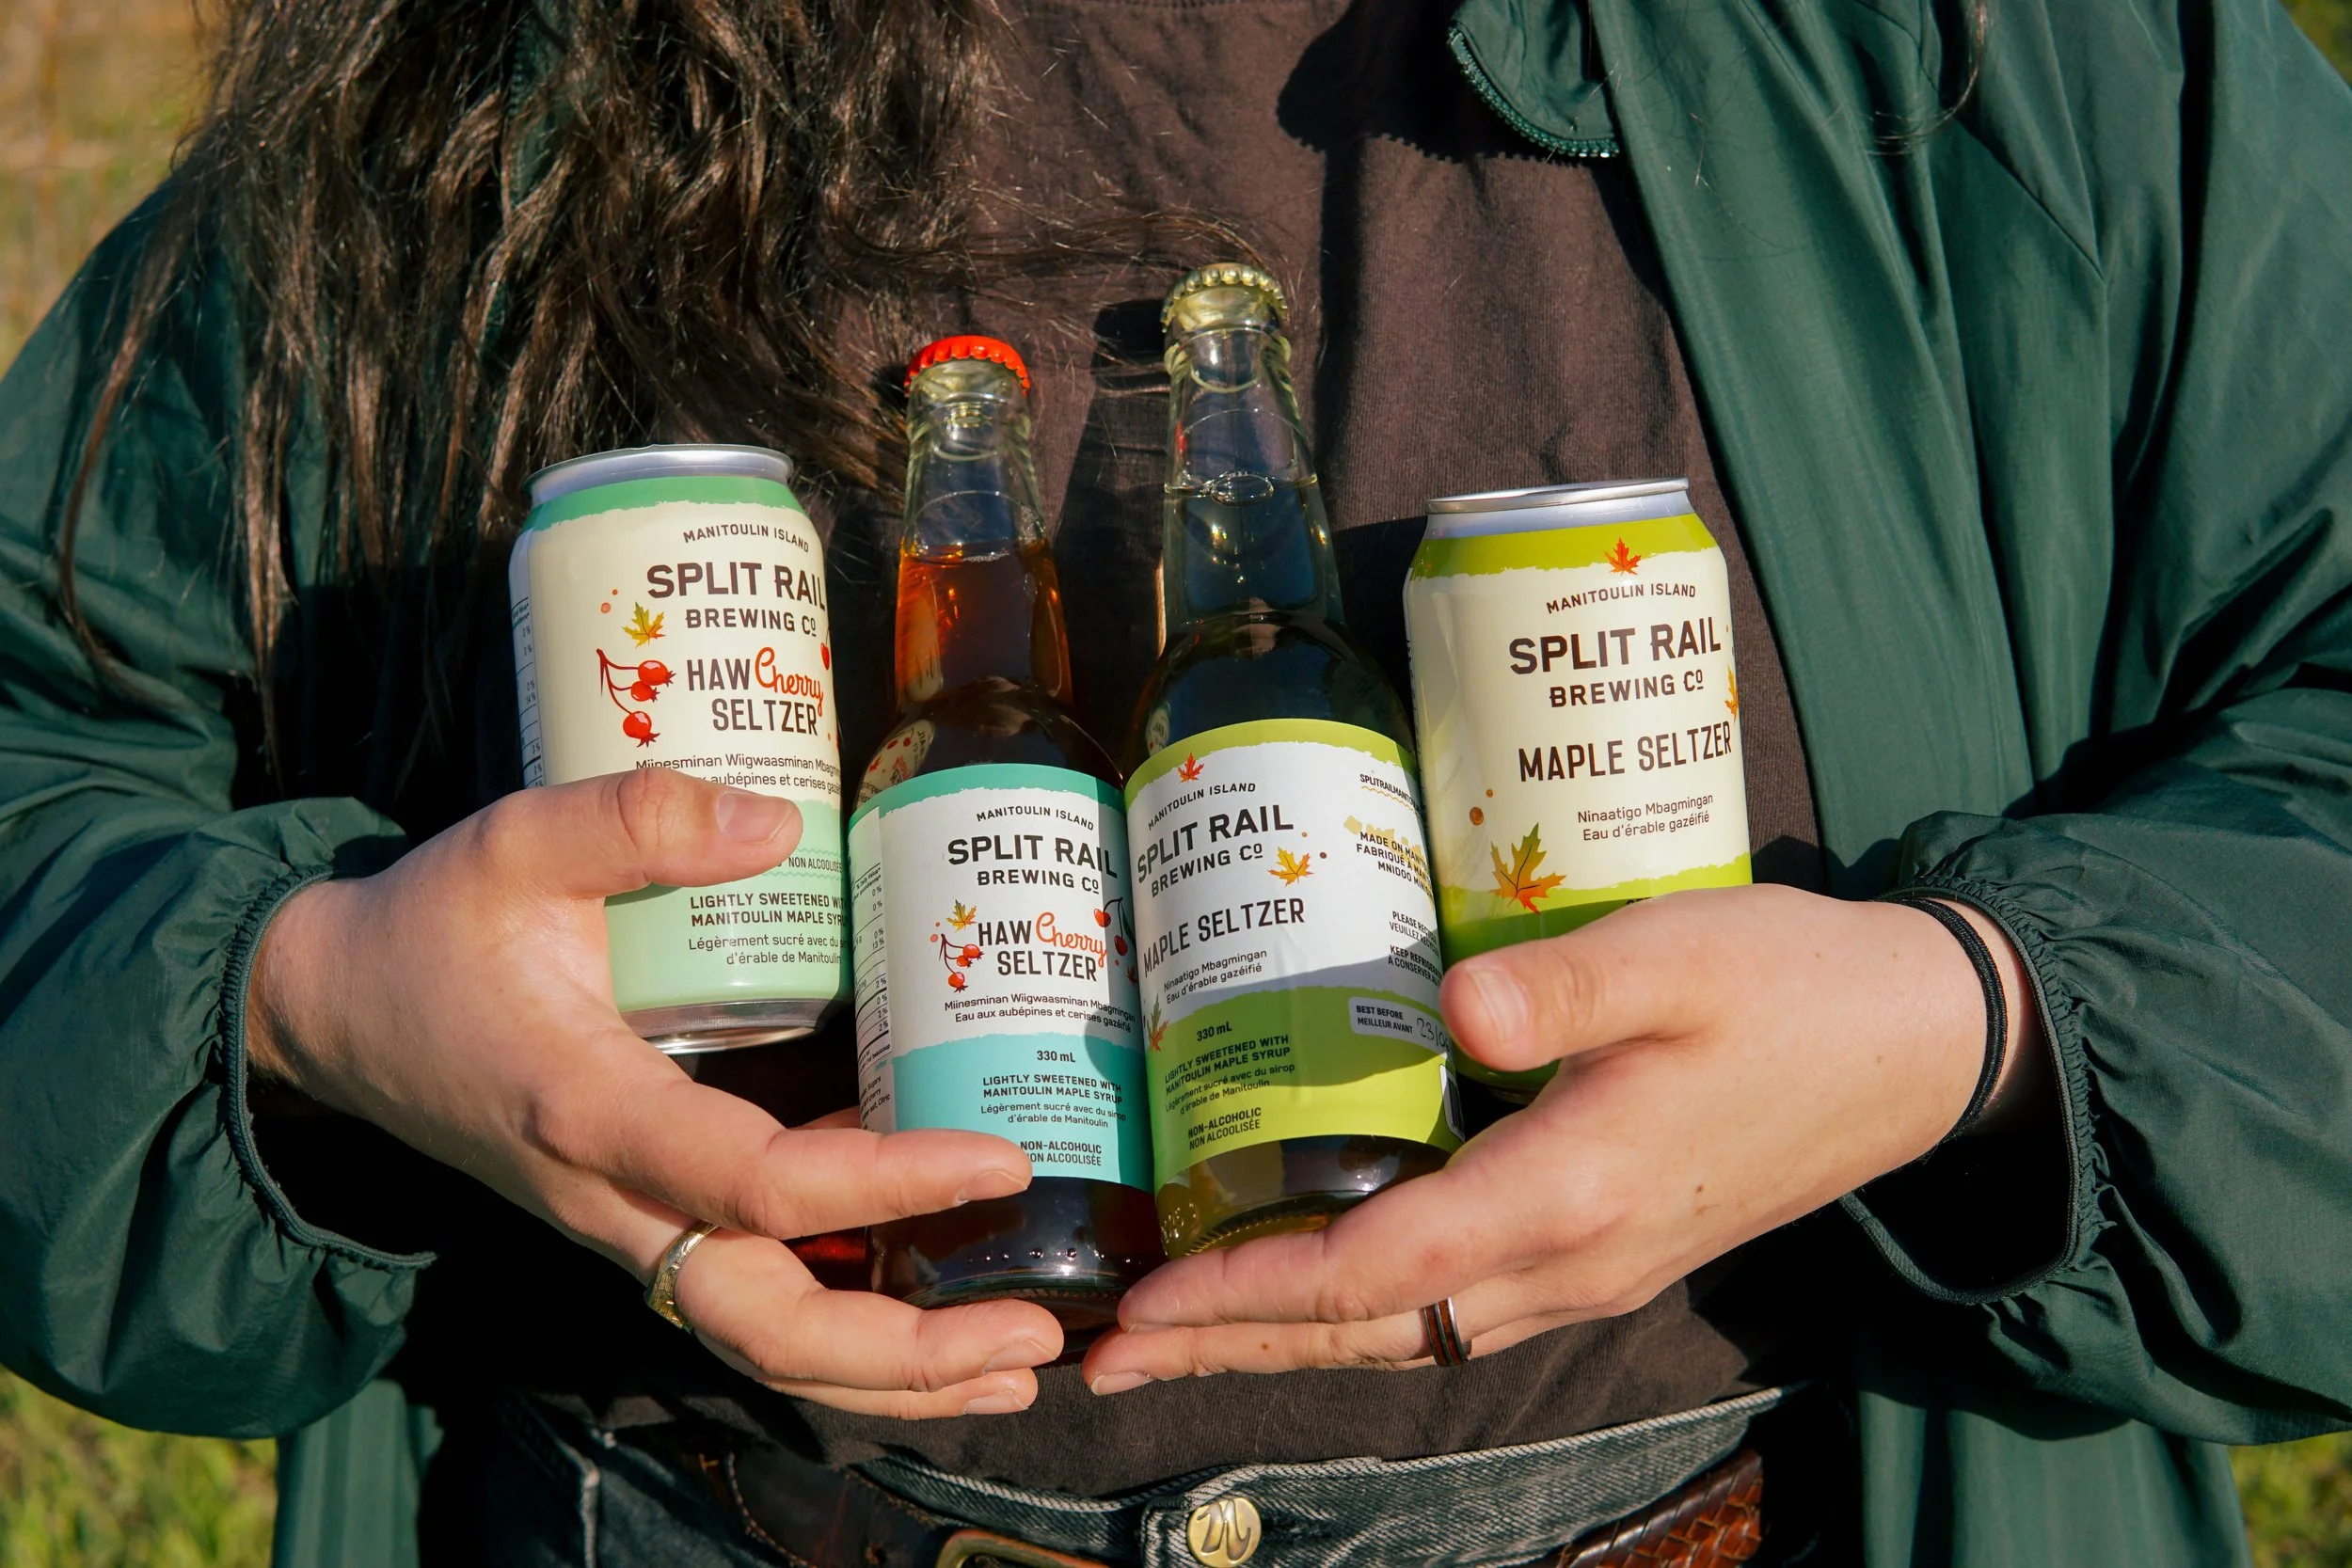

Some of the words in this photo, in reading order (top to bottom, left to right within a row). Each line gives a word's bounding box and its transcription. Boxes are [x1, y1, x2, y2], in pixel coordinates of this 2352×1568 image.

[683, 524, 769, 543] MANITOULIN
[774, 528, 809, 552] ISLAND
[647, 562, 762, 598] SPLIT
[774, 564, 825, 610] RAIL
[1547, 584, 1645, 614] MANITOULIN
[1650, 583, 1696, 597] ISLAND
[685, 609, 795, 632] BREWING
[1509, 627, 1635, 674] SPLIT
[1650, 616, 1721, 661] RAIL
[687, 658, 750, 691] HAW
[755, 646, 823, 717] Cherry
[1549, 673, 1676, 707] BREWING
[711, 698, 818, 736] SELTZER
[636, 755, 722, 769] Miinesminan
[725, 753, 814, 769] Wiigwaasminan
[1518, 740, 1626, 782] MAPLE
[1637, 721, 1732, 771] SELTZER
[711, 772, 776, 787] aubépines
[780, 775, 789, 784] et
[793, 776, 826, 790] cerises
[977, 805, 1051, 821] MANITOULIN
[1056, 809, 1094, 831] ISLAND
[1148, 789, 1204, 831] MANITOULIN
[1209, 783, 1256, 796] ISLAND
[1578, 805, 1642, 823] Ninaatigo
[1645, 794, 1713, 816] Mbagmingan
[1583, 829, 1609, 841] Eau
[1613, 820, 1665, 838] d'érable
[1669, 811, 1709, 832] gazéifié
[1137, 821, 1198, 883] SPLIT
[1209, 804, 1294, 843] RAIL
[1360, 832, 1389, 847] MADE
[1391, 841, 1403, 853] ON
[788, 857, 806, 868] NON
[948, 834, 1043, 865] SPLIT
[1055, 837, 1118, 879] RAIL
[1356, 844, 1405, 866] FABRIQUÉ
[977, 869, 1074, 888] BREWING
[1151, 849, 1231, 898] BREWING
[1377, 861, 1411, 882] MNIDOO
[690, 894, 753, 910] LIGHTLY
[759, 893, 830, 908] SWEETENED
[691, 911, 782, 927] MANITOULIN
[787, 912, 823, 925] MAPLE
[1392, 911, 1417, 929] PLEASE
[689, 934, 769, 952] Légèrement
[772, 934, 803, 946] sucré
[830, 936, 838, 947] du
[978, 920, 1031, 946] HAW
[1036, 911, 1106, 967] Cherry
[1144, 922, 1190, 978] MAPLE
[1198, 897, 1305, 942] SELTZER
[1389, 922, 1420, 942] VEUILLEZ
[726, 952, 778, 965] d'érable
[782, 952, 795, 963] de
[1390, 945, 1408, 958] KEEP
[997, 950, 1097, 982] SELTZER
[1164, 967, 1200, 992] Ninaatigo
[1201, 950, 1267, 971] Mbagmingan
[1167, 992, 1180, 1004] Eau
[1182, 974, 1217, 996] d'érable
[1221, 962, 1263, 982] gazéifié
[945, 993, 1009, 1011] Miinesminan
[1010, 993, 1089, 1008] Wiigwaasminan
[1090, 999, 1136, 1022] Mbagmingan
[955, 1012, 975, 1022] Eau
[998, 1006, 1053, 1020] aubépines
[1068, 1010, 1102, 1022] cerises
[1356, 1005, 1375, 1014] BEST
[1377, 1007, 1404, 1020] BEFORE
[1197, 1026, 1215, 1041] 330
[1216, 1021, 1232, 1034] mL
[1358, 1017, 1391, 1029] MEILLEUR
[1393, 1022, 1413, 1034] AVANT
[1037, 1051, 1057, 1061] 330
[1060, 1053, 1075, 1063] mL
[1165, 1060, 1193, 1084] LIGHTLY
[1196, 1040, 1256, 1066] SWEETENED
[1259, 1035, 1289, 1047] WITH
[1166, 1065, 1211, 1096] MANITOULIN
[1214, 1053, 1248, 1071] MAPLE
[1252, 1047, 1291, 1061] SYRUP
[1203, 1075, 1228, 1091] sucré
[1230, 1071, 1252, 1083] avec
[1254, 1066, 1266, 1076] du
[1269, 1064, 1295, 1074] sirop
[982, 1074, 1029, 1086] LIGHTLY
[1034, 1074, 1097, 1087] SWEETENED
[1100, 1081, 1121, 1093] WITH
[983, 1086, 1053, 1098] MANITOULIN
[1056, 1086, 1090, 1099] MAPLE
[1094, 1091, 1122, 1104] SYRUP
[1210, 1092, 1220, 1101] de
[1222, 1080, 1270, 1096] Manitoulin
[981, 1102, 1041, 1115] Légèrement
[1043, 1103, 1071, 1112] sucré
[1095, 1106, 1105, 1117] du
[1107, 1109, 1126, 1121] sirop
[1008, 1114, 1048, 1124] d'érable
[1065, 1116, 1108, 1128] Manitoulin
[1188, 1107, 1262, 1138] NON-ALCOHOLIC
[1189, 1136, 1205, 1150] NON
[1206, 1118, 1261, 1146] ALCOOLISÉE
[1020, 1141, 1102, 1154] NON-ALCOHOLIC
[1046, 1153, 1102, 1166] ALCOOLISÉE
